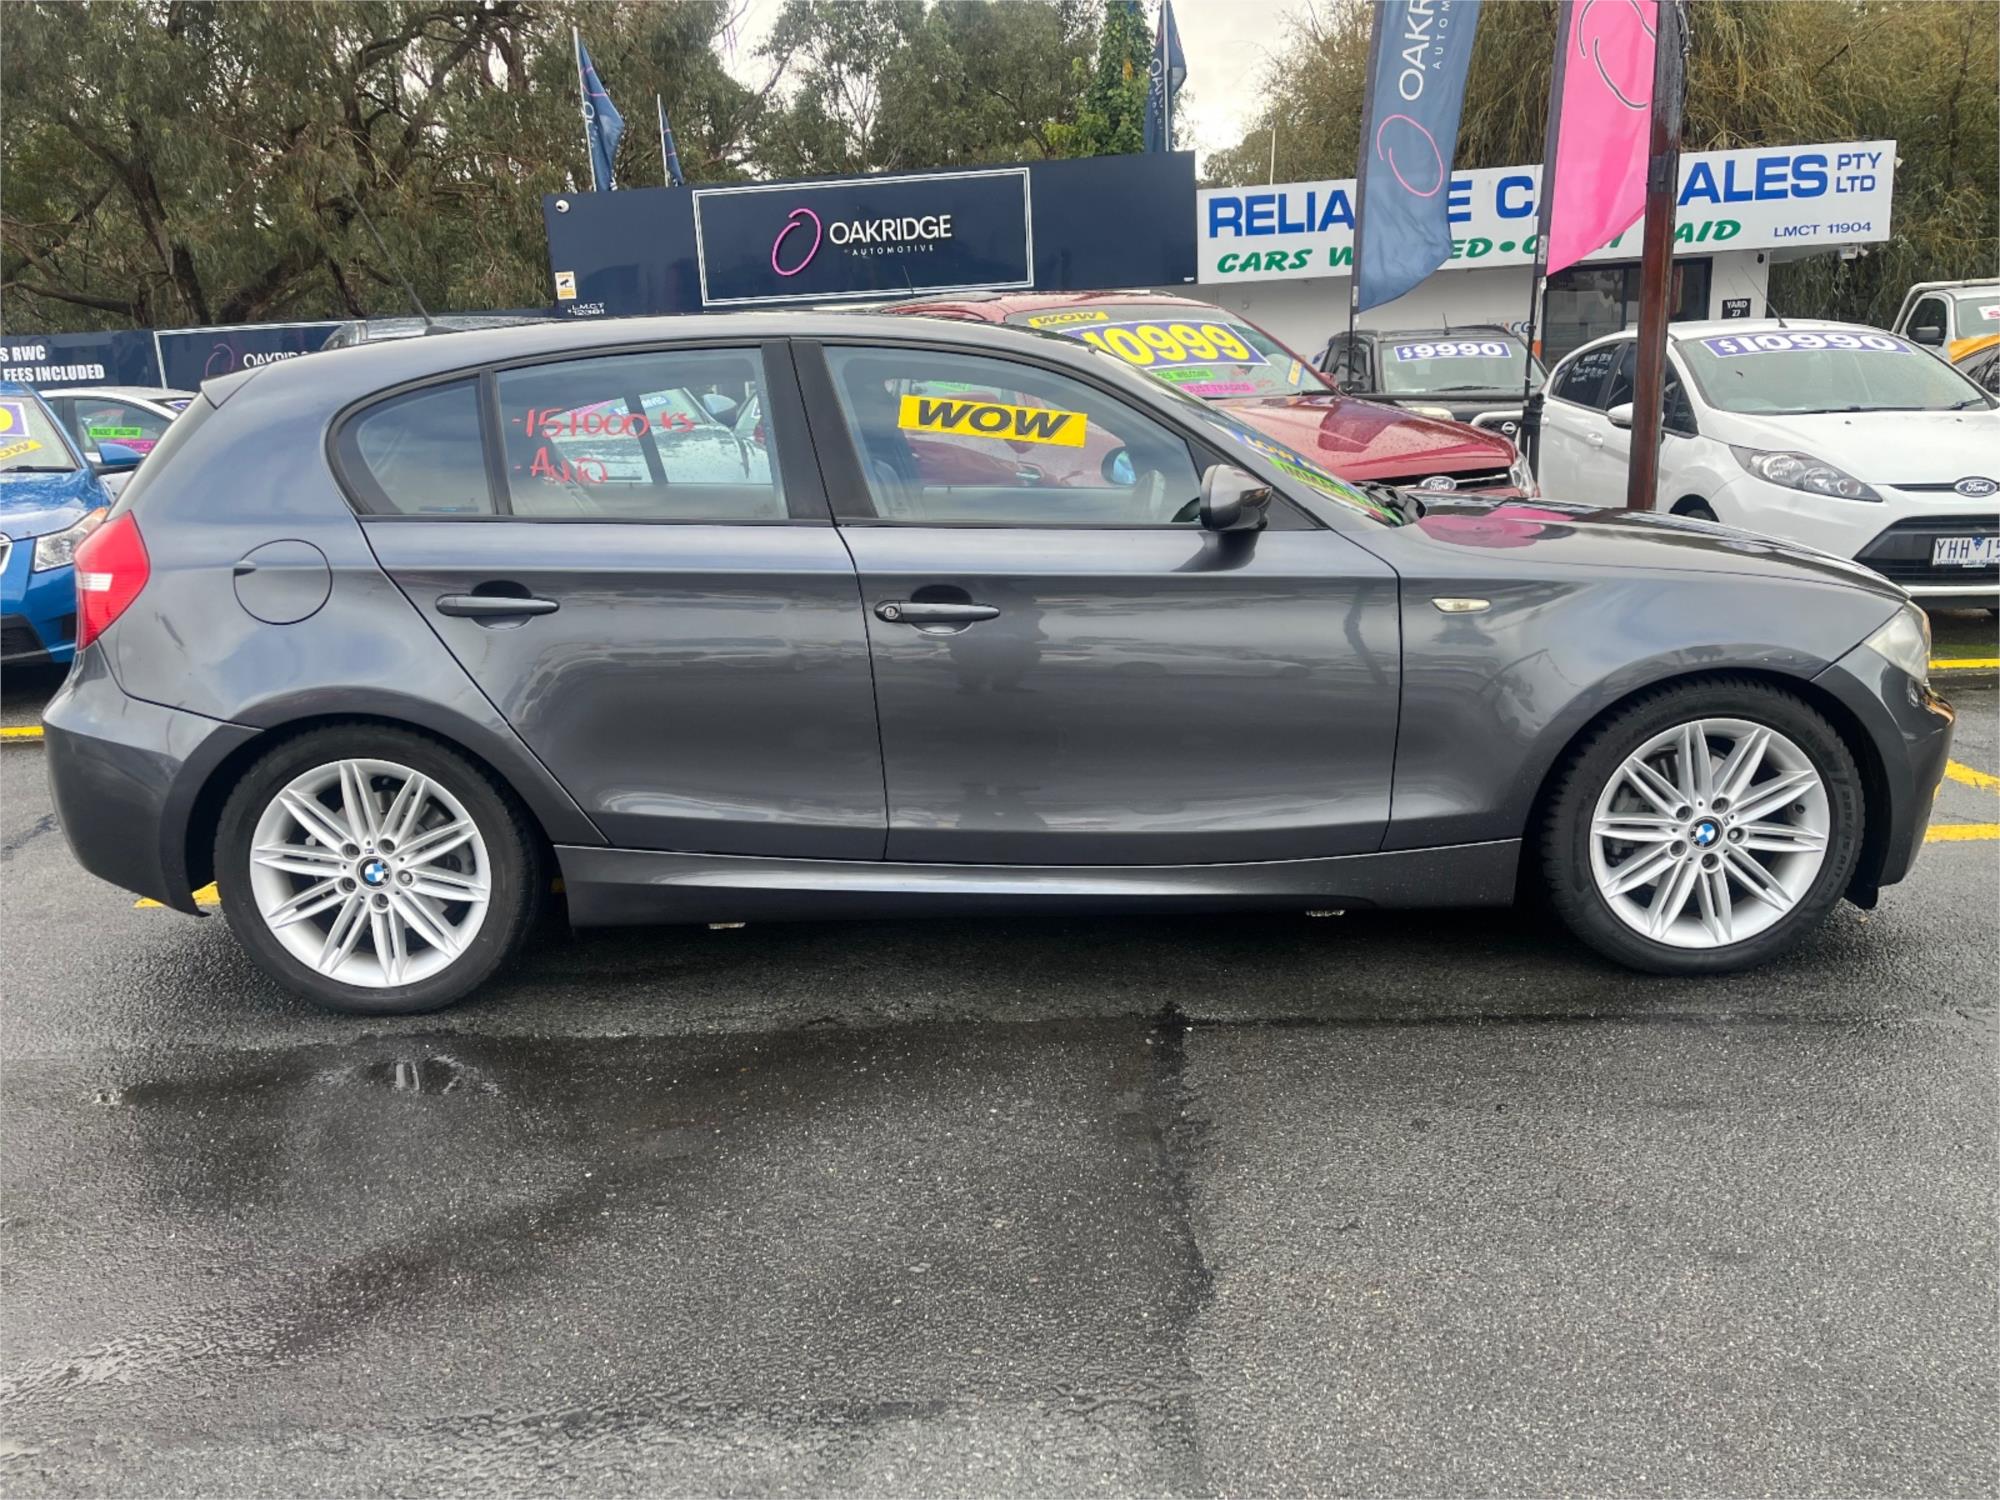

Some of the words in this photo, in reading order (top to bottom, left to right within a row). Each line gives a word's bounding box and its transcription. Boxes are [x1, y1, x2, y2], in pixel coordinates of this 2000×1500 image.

[1837, 152, 1882, 170] PTY
[1676, 153, 1828, 207] ALES
[1835, 175, 1876, 193] LTD
[829, 214, 952, 245] OAKRIDGE
[1773, 224, 1821, 238] LMCT
[1826, 221, 1873, 235] 11904
[851, 244, 934, 257] AUTOMOTIVE
[1217, 248, 1313, 274] CARS
[1673, 219, 1742, 244] AID
[1727, 300, 1748, 309] YARD
[1732, 309, 1741, 317] 27
[1036, 312, 1099, 325] WOW
[1402, 343, 1504, 359] $9990
[1718, 334, 1898, 353] $10990
[11, 344, 46, 362] RWC
[2, 366, 35, 382] FEES
[34, 363, 105, 382] INCLUDED
[918, 399, 1073, 439] WOW
[1936, 539, 1971, 560] YHH
